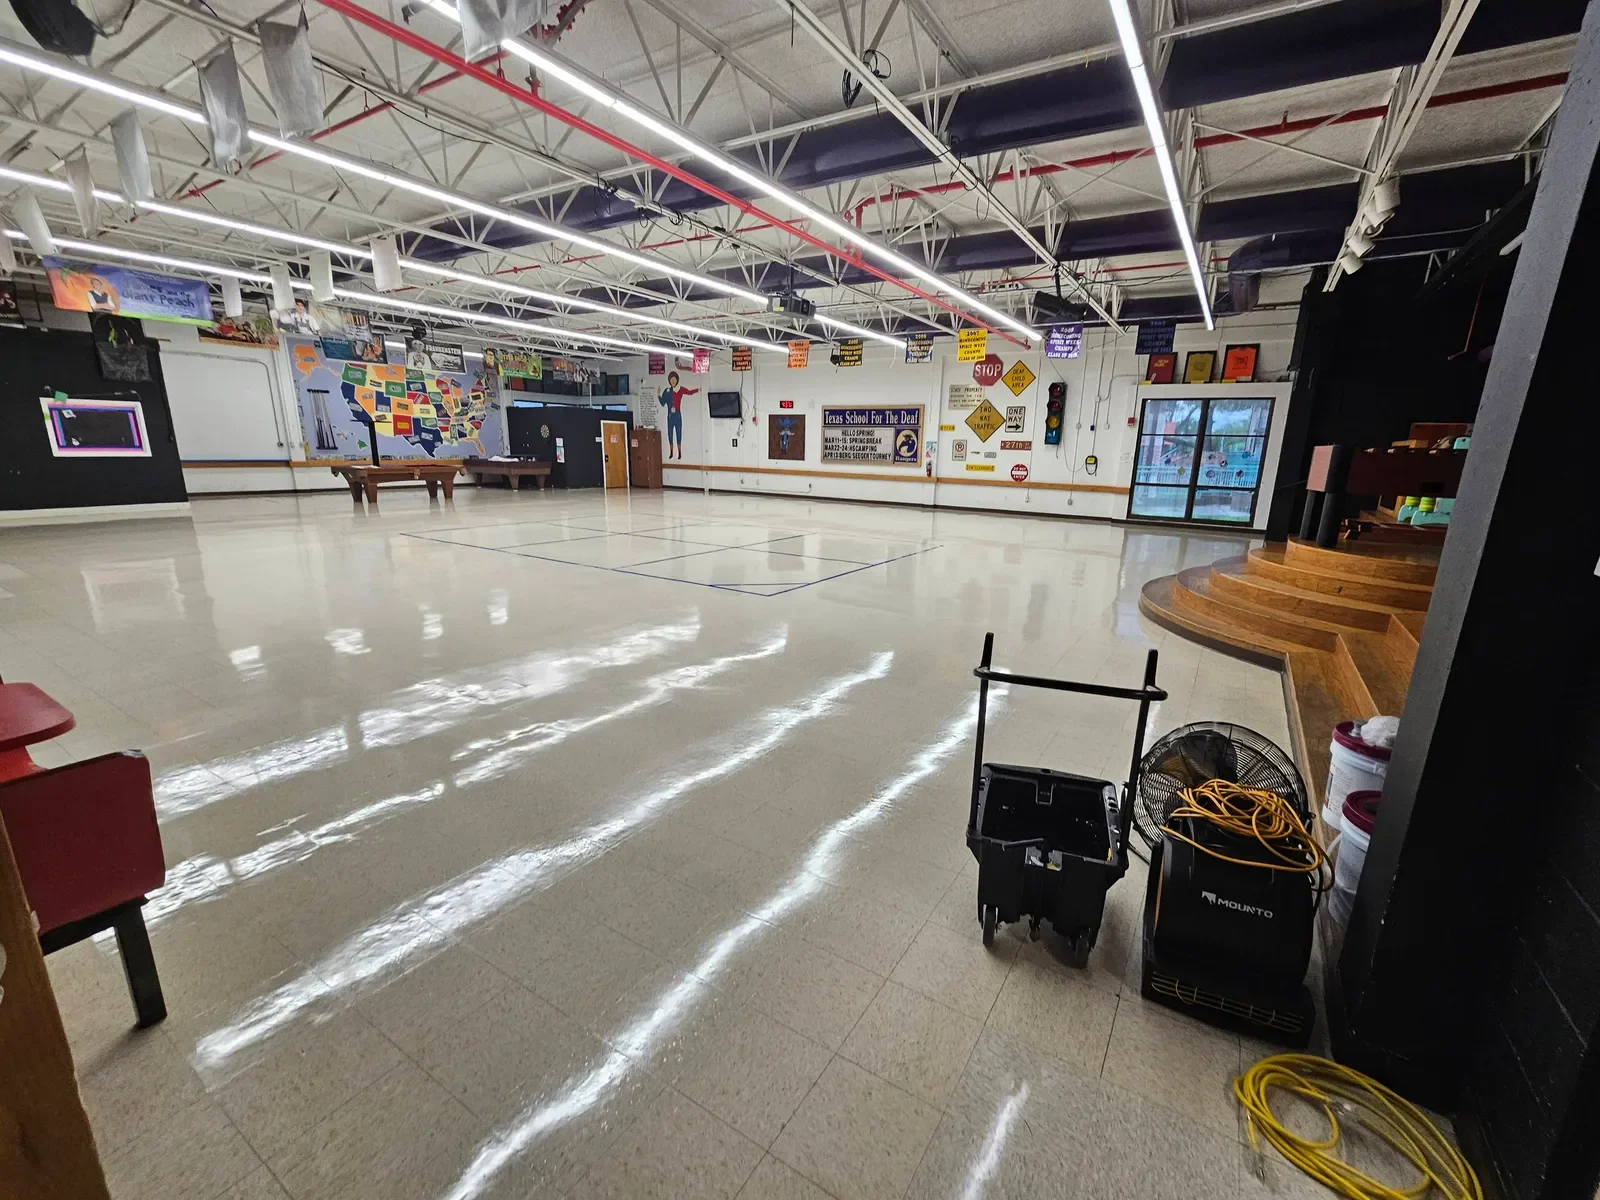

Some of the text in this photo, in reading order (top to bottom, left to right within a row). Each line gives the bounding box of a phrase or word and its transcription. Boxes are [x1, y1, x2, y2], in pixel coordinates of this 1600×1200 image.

[122, 289, 196, 308] Giant Peach
[426, 344, 461, 355] FRANKENSTEIN
[974, 364, 1001, 376] STOP
[825, 411, 918, 424] Texas School For The Deaf
[1218, 898, 1273, 918] MOUNTO
